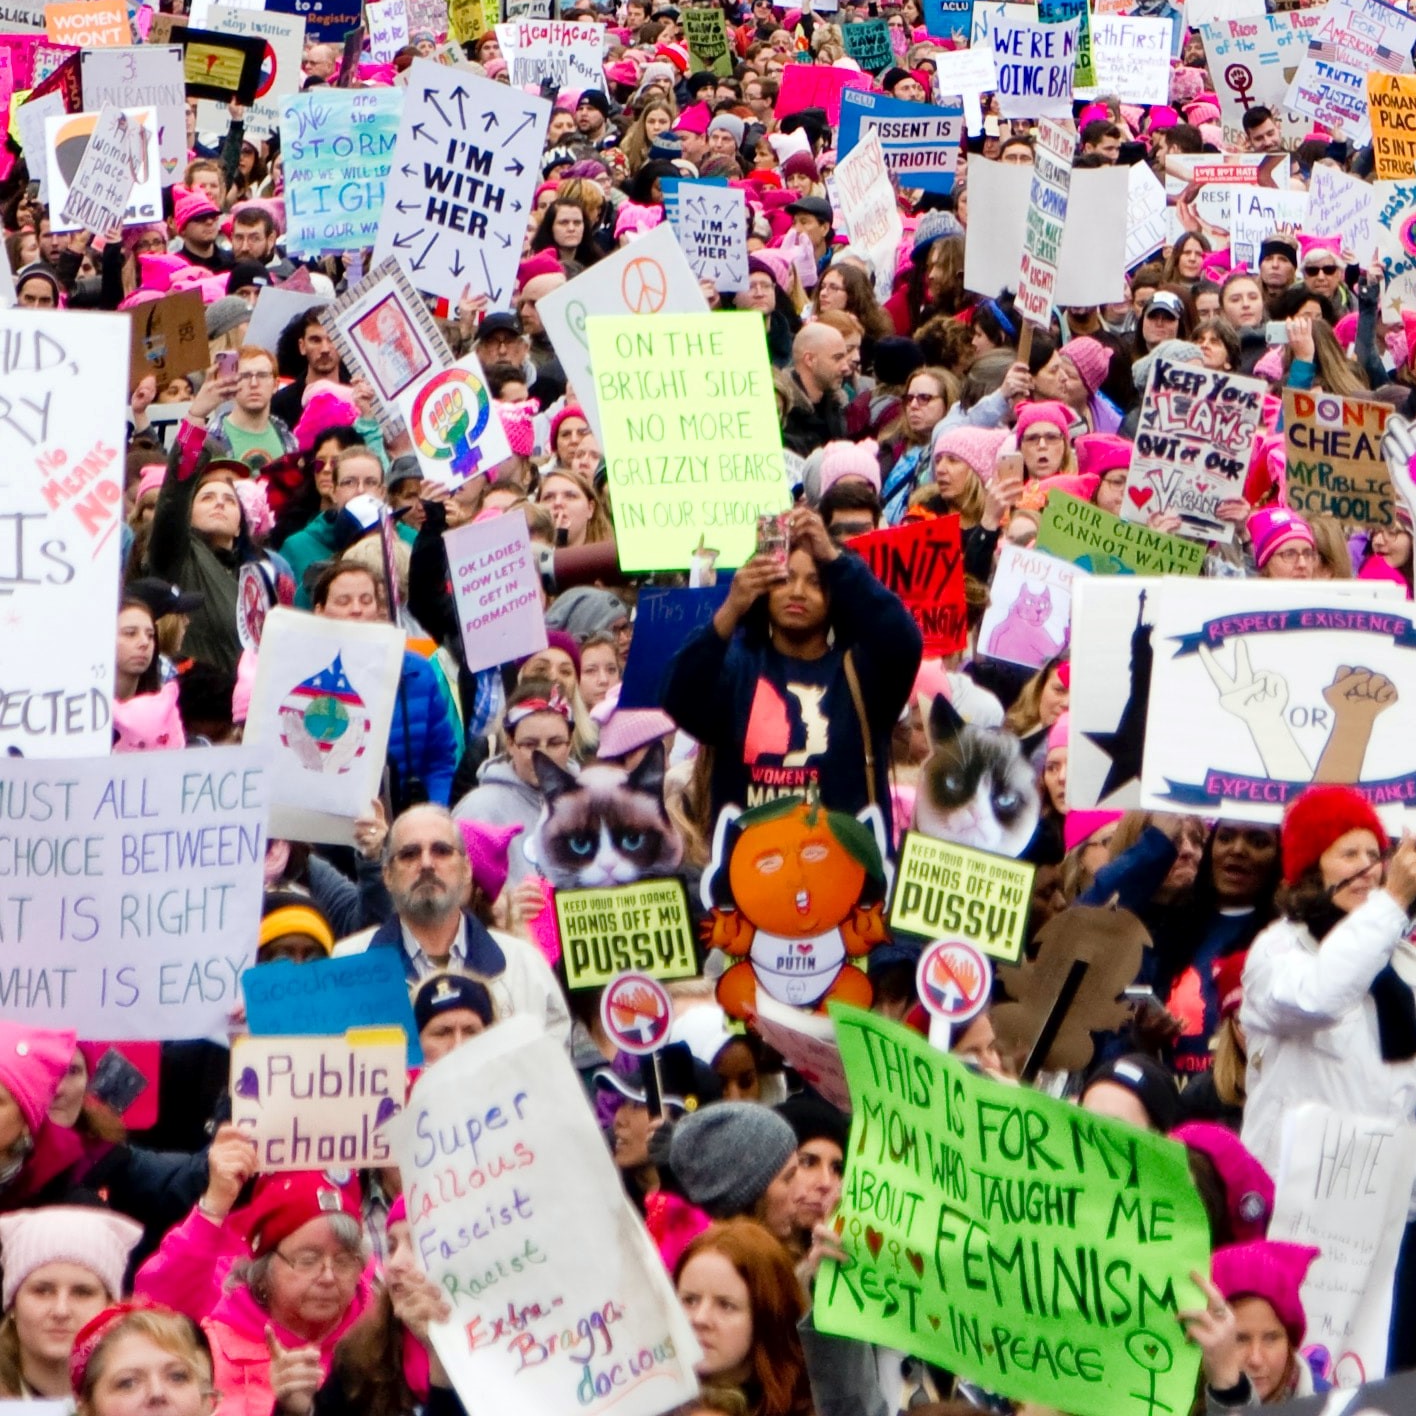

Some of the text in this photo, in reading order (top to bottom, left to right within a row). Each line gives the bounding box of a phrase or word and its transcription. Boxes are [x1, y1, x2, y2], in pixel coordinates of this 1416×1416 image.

[53, 10, 121, 29] WOMEN
[942, 1, 968, 11] ACLU
[995, 27, 1055, 58] WE'RE
[1315, 62, 1363, 88] TRUTH
[1391, 77, 1400, 91] A
[351, 110, 375, 124] the
[353, 94, 378, 108] are
[869, 121, 951, 139] DISSENT IS
[291, 133, 398, 160] STORM
[445, 137, 495, 175] I'M
[1377, 138, 1390, 155] IS
[423, 161, 507, 214] WITH
[323, 224, 356, 239] OUR
[424, 196, 490, 241] HER
[700, 219, 723, 232] I'M
[694, 232, 732, 247] WITH
[698, 245, 728, 260] HER
[616, 331, 724, 358] ON THE
[600, 370, 761, 401] BRIGHT SIDE
[627, 411, 752, 443] NO MORE
[612, 453, 782, 486] GRIZZLY BEARS
[72, 480, 122, 539] NO
[620, 501, 696, 529] IN OUR
[1288, 489, 1394, 525] SCHOOLS
[1052, 515, 1131, 558] CANNOT
[1066, 501, 1201, 563] OUR CLIMATE
[458, 561, 477, 578] OK
[462, 556, 526, 596] NOW LET'S
[479, 580, 518, 607] GET IN
[466, 590, 537, 633] FORMATION
[1207, 611, 1407, 642] RESPECT EXISTENCE
[1290, 705, 1328, 729] OR
[750, 768, 819, 786] WOMEN'S
[1206, 775, 1288, 801] EXPECT
[94, 769, 264, 820] ALL FACE
[122, 824, 262, 876] BETWEEN
[906, 860, 995, 899] HANDS OFF
[59, 886, 235, 940] IS RIGHT
[566, 905, 681, 934] HANDS OFF MY
[899, 882, 1017, 950] PUSSY!
[570, 926, 689, 976] PUSSY!
[776, 955, 816, 971] PUTIN
[101, 953, 247, 1008] IS EASY
[266, 1053, 389, 1100] Public
[839, 1019, 1137, 1186] THIS FOR MY
[413, 1090, 528, 1170] Super
[856, 1098, 1174, 1242] MOM WHO TAUGHT ME
[419, 1188, 534, 1271] Fascist
[844, 1165, 925, 1240] ABOUT
[933, 1204, 1189, 1334] FEMINISM
[828, 1255, 1105, 1381] REST PEACE
[577, 1334, 676, 1406] docious
